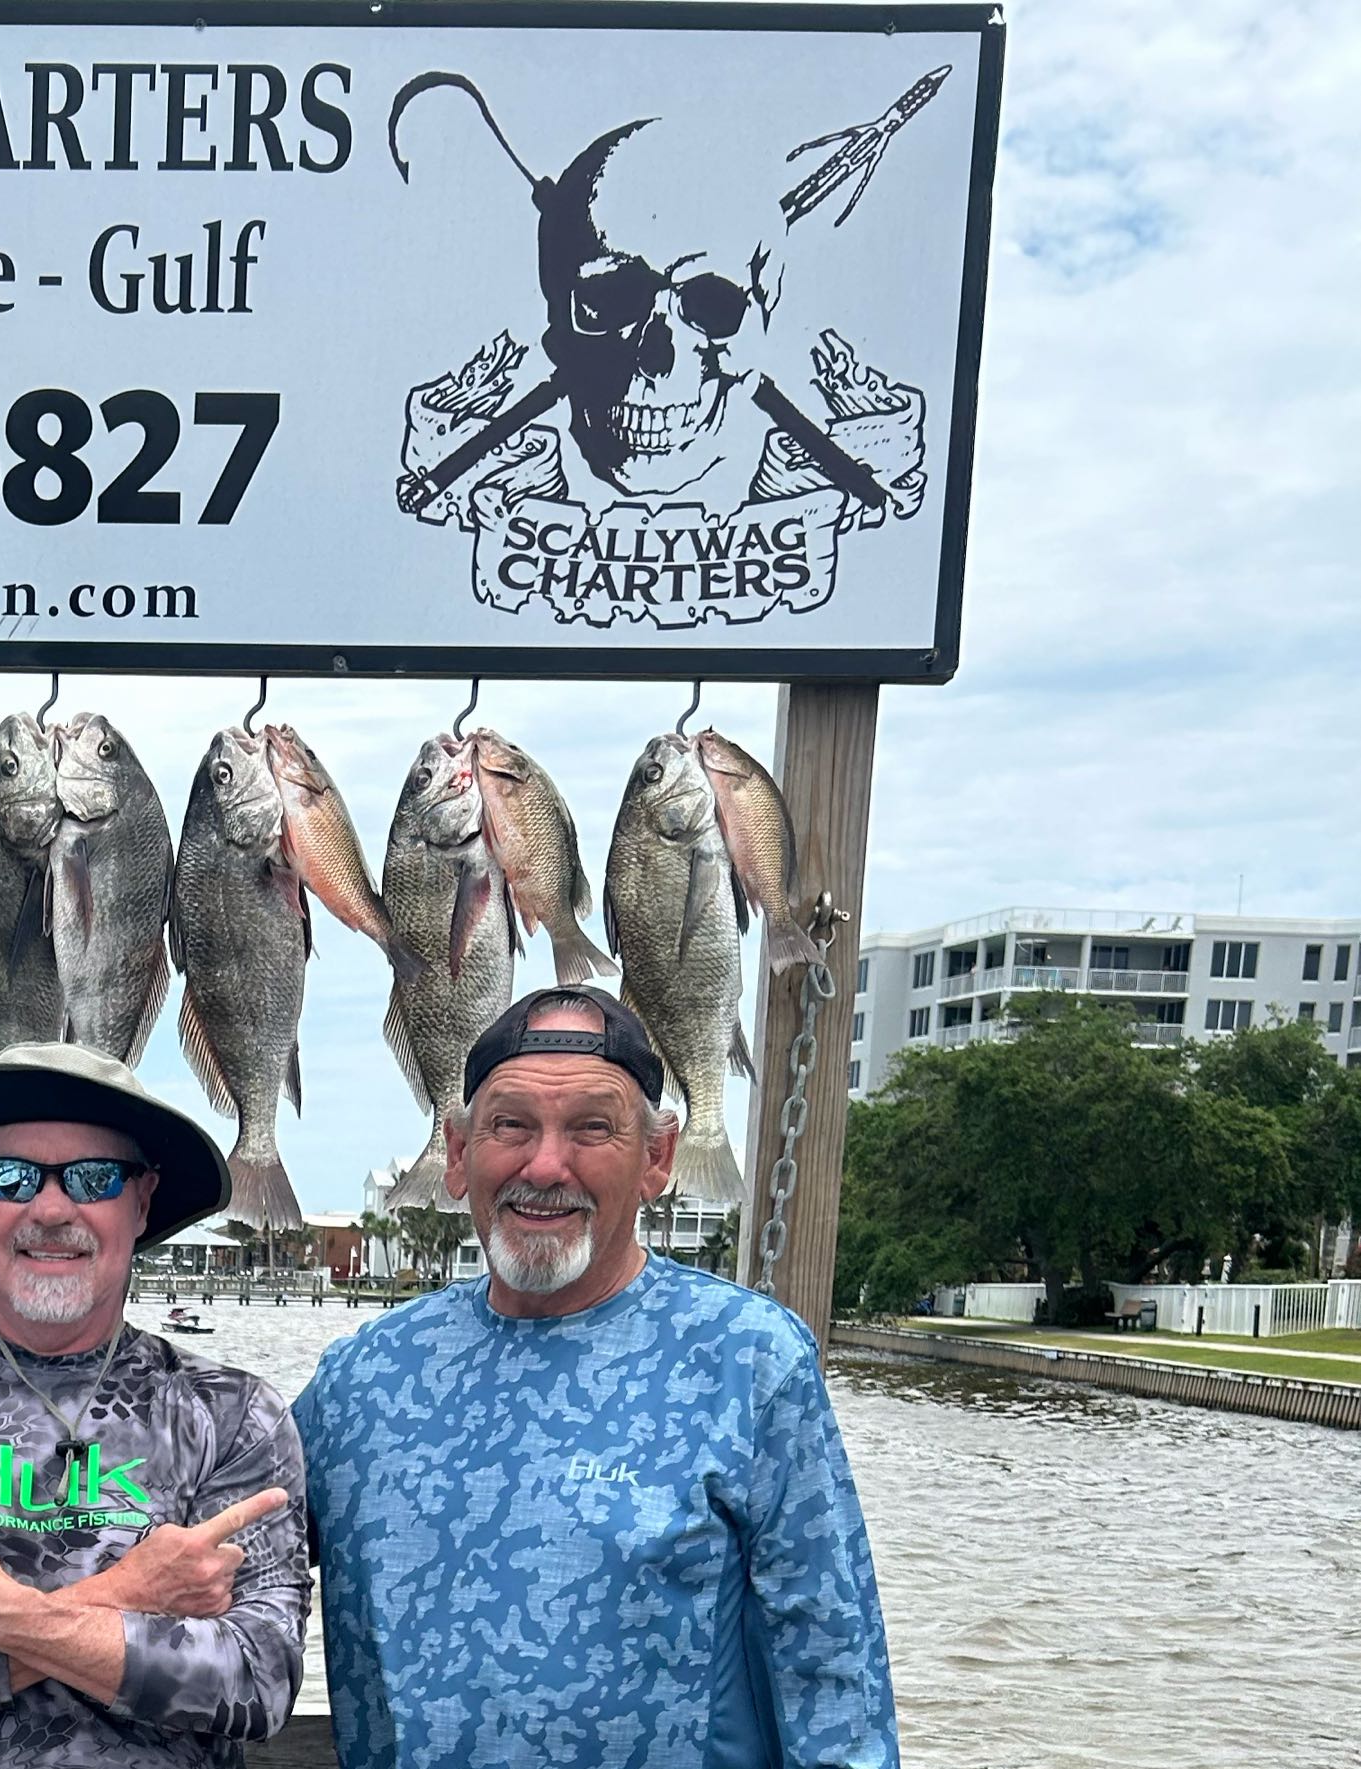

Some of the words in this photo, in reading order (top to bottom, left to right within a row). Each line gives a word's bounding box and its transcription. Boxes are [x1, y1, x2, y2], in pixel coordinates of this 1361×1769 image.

[88, 219, 268, 315] Gulf
[502, 515, 808, 563] SCALLYWAG
[497, 550, 812, 605] CHARTERS
[568, 1456, 640, 1487] Huk
